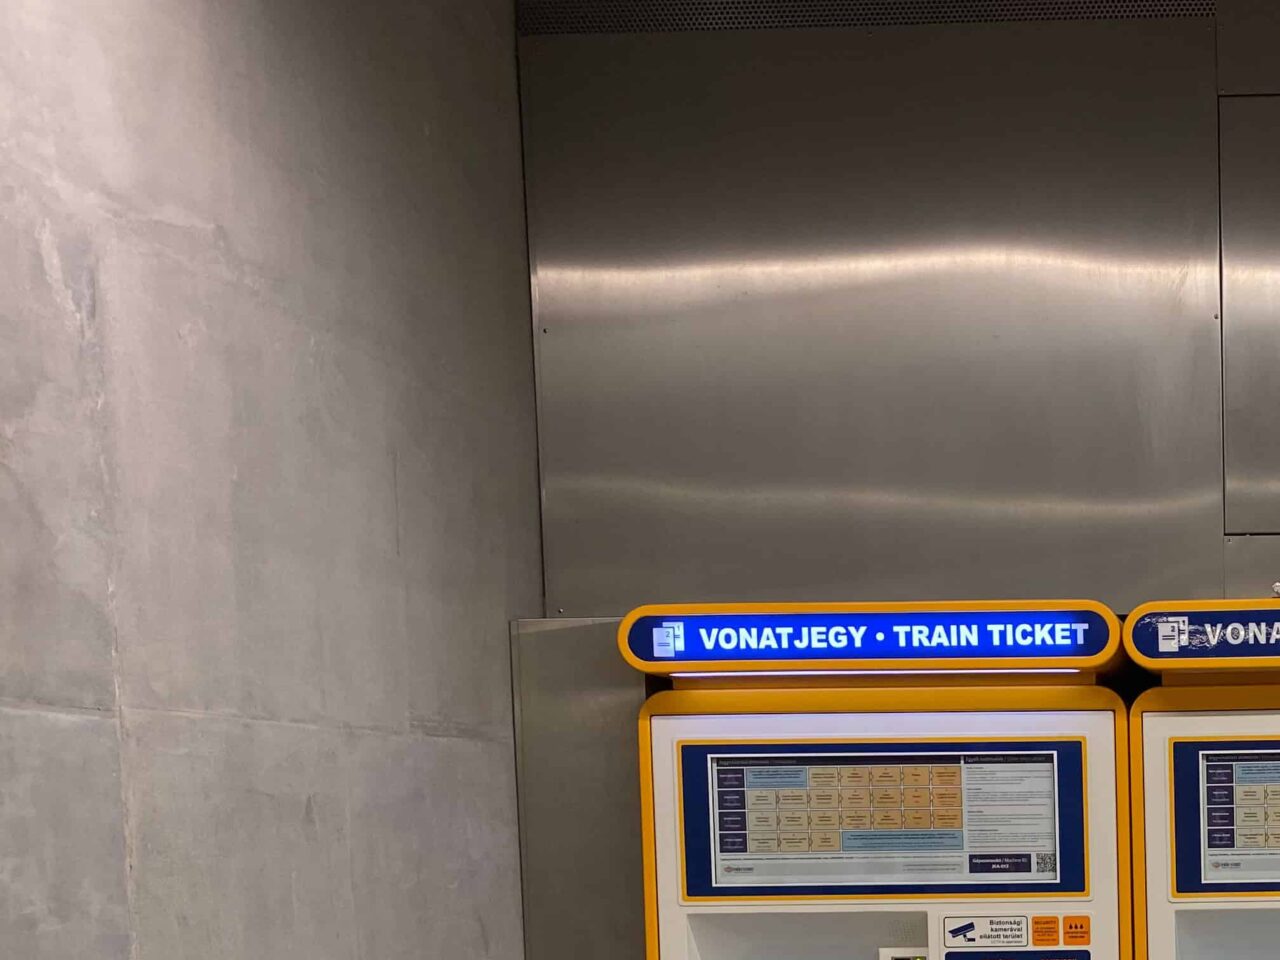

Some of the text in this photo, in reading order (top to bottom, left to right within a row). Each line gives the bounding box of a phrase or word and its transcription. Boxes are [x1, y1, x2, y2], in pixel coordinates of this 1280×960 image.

[699, 623, 1089, 650] VONATJEGY TRAIN TICKET
